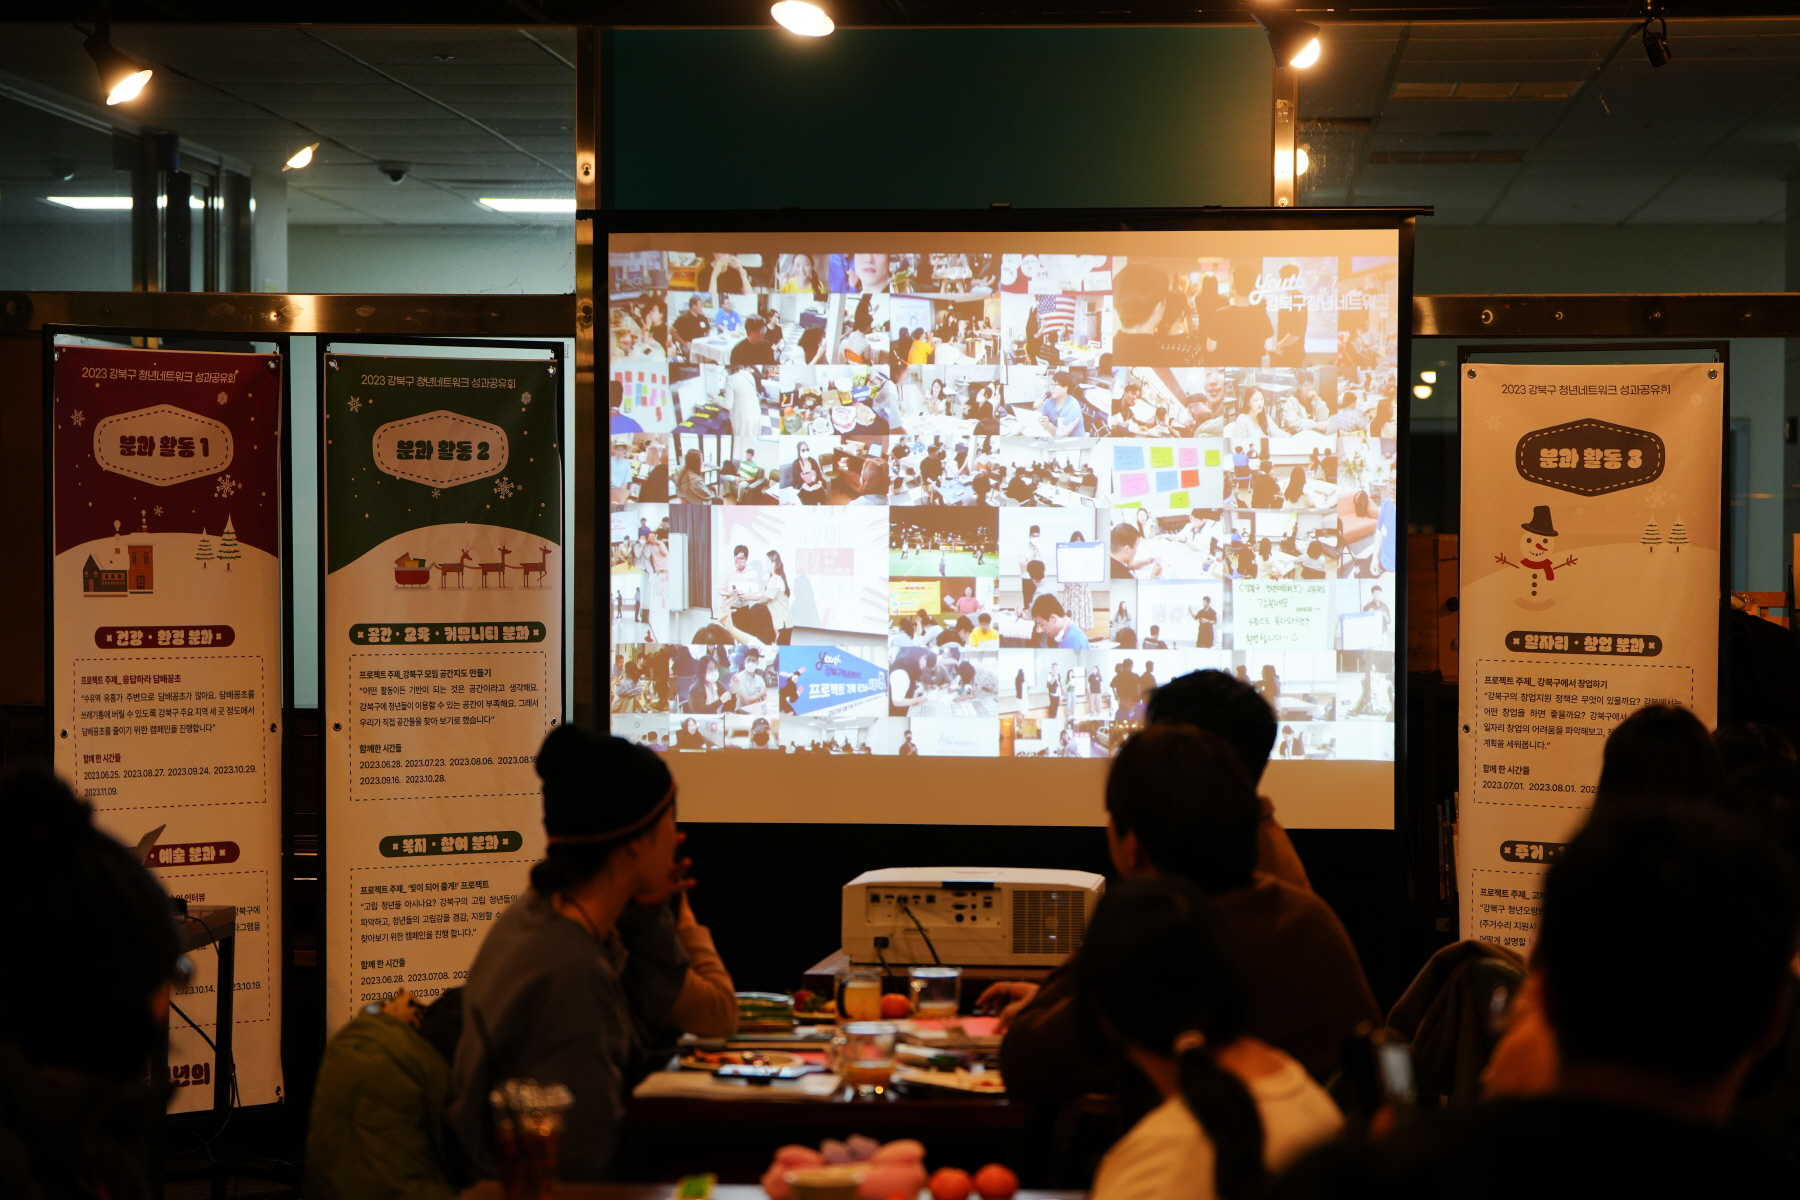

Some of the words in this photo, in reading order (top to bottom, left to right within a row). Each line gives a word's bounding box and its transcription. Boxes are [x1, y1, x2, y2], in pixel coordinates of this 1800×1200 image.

[81, 367, 107, 379] 2023
[109, 369, 136, 380] 강북구
[139, 370, 193, 382] 청년네트워크
[195, 372, 236, 384] 성과공유회
[361, 374, 385, 385] 2023
[388, 376, 414, 387] 강북구
[416, 376, 469, 388] 청년네트워크
[472, 378, 516, 389] 성과공유회
[1502, 384, 1526, 394] 2023
[1528, 384, 1557, 395] 강북구
[1559, 385, 1617, 396] 청년네트워크
[119, 435, 156, 457] 분과
[160, 436, 195, 458] 활동
[200, 438, 210, 457] 1
[396, 440, 433, 460] 분과
[438, 440, 473, 461] 활동
[477, 441, 490, 461] 2
[1540, 448, 1579, 469] 분과
[1583, 448, 1622, 470] 활동
[1627, 449, 1642, 469] 3
[116, 630, 143, 646] 건강
[158, 630, 185, 646] 환경
[188, 629, 213, 645] 분과
[368, 626, 393, 642] 공간
[404, 626, 430, 642] 교육
[444, 625, 499, 641] 커뮤니티
[502, 625, 529, 641] 분과
[1524, 634, 1569, 651] 일자리
[1583, 636, 1612, 652] 창업
[1616, 637, 1645, 653] 분과
[81, 675, 103, 685] 프로젝트
[122, 674, 151, 684] 응답하라
[153, 674, 181, 684] 담배꽁초
[359, 670, 387, 679] 프로젝트
[424, 670, 438, 679] 모임
[440, 669, 468, 679] 공간지도
[470, 668, 492, 678] 만들기
[359, 686, 377, 695] “어떤
[381, 686, 406, 695] 활동이든
[409, 685, 428, 694] 기반이
[433, 685, 447, 694] 되는
[451, 684, 465, 694] 것은
[469, 684, 505, 693] 공간이라고
[510, 683, 538, 692] 생각해요.
[1484, 676, 1514, 685] 프로젝트
[1538, 678, 1576, 688] 강북구에서
[1578, 679, 1607, 689] 창업하기
[104, 693, 123, 703] 유흥가
[126, 692, 155, 702] 주변으로
[158, 692, 192, 702] 담배꽁초가
[195, 690, 216, 700] 많아요.
[219, 690, 255, 700] 담배꽁초를
[1484, 692, 1517, 701] “강북구의
[1521, 693, 1551, 702] 창업지원
[1555, 694, 1578, 703] 정책은
[1581, 695, 1604, 705] 무엇이
[1607, 696, 1640, 706] 있을까요?
[359, 702, 387, 712] 강북구에
[388, 702, 413, 711] 청년들이
[415, 701, 436, 710] 이용할
[437, 701, 444, 709] 수
[446, 700, 460, 709] 있는
[462, 700, 484, 709] 공간이
[486, 699, 516, 708] 부족해요.
[518, 699, 539, 708] 그래서
[81, 710, 111, 720] 쓰레기통에
[112, 710, 125, 719] 버릴
[127, 710, 133, 718] 수
[135, 709, 157, 718] 있도록
[158, 708, 179, 718] 강북구
[180, 708, 193, 717] 주요
[195, 707, 208, 716] 지역
[226, 706, 254, 716] 정도에서
[1484, 707, 1498, 717] 어떤
[1502, 708, 1525, 717] 창업을
[1530, 709, 1546, 718] 하면
[1550, 709, 1586, 719] 좋을까요?
[1590, 711, 1627, 721] 강북구에서
[359, 718, 381, 727] 우리가
[382, 718, 395, 727] 직접
[397, 717, 422, 726] 공간들을
[423, 716, 438, 726] 찾아
[440, 716, 461, 725] 보기로
[81, 727, 111, 737] 담배꽁초를
[112, 726, 132, 735] 줄이기
[134, 725, 148, 735] 위한
[150, 724, 178, 734] 캠페인을
[179, 723, 216, 733] 진행합니다”
[1484, 723, 1505, 733] 일자리
[1507, 724, 1529, 733] 창업의
[1532, 725, 1563, 735] 어려움을
[1565, 726, 1605, 737] 파악해보고,
[383, 743, 402, 753] 시간들
[1483, 739, 1504, 748] 계획을
[83, 754, 94, 764] 함께
[103, 753, 121, 763] 시간들
[360, 760, 402, 769] 2023.06.28.
[405, 759, 446, 768] 2023.07.23.
[450, 757, 494, 766] 2023.08.06.
[84, 771, 120, 780] 2023.06.25.
[124, 769, 164, 778] 2023.08.27.
[168, 767, 210, 776] 2023.09.24.
[214, 765, 257, 774] 2023.10.29.
[1483, 764, 1497, 774] 함께
[1507, 766, 1530, 776] 시간들
[360, 776, 401, 785] 2023.09.16.
[406, 774, 446, 784] 2023.10.28.
[85, 787, 118, 796] 2023.11.09.
[1482, 780, 1524, 790] 2023.07.01.
[1529, 783, 1576, 793] 2023.08.01.
[402, 838, 426, 854] 복지
[440, 835, 468, 852] 참여
[472, 835, 499, 851] 분과
[158, 847, 185, 864] 예술
[189, 845, 216, 862] 분과
[1515, 844, 1544, 860] 주거
[360, 885, 388, 894] 프로젝트
[425, 883, 439, 892] 되어
[461, 880, 489, 889] 프로젝트
[1480, 888, 1509, 898] 프로젝트
[185, 893, 205, 902] 인터뷰
[360, 902, 378, 910] “고립
[381, 901, 401, 910] 청년을
[404, 899, 436, 908] 아시나요?
[440, 897, 468, 907] 강북구의
[472, 896, 485, 905] 고립
[1480, 904, 1505, 913] “강북구
[360, 917, 390, 927] 파악하고,
[392, 915, 420, 925] 청년들의
[422, 914, 450, 923] 고립감을
[453, 912, 468, 922] 경감,
[471, 911, 492, 921] 지원할
[1480, 920, 1511, 930] (주거수리
[361, 933, 389, 943] 찾아보기
[390, 932, 404, 941] 위한
[405, 931, 433, 940] 캠페인을
[435, 930, 448, 939] 진행
[1503, 937, 1526, 946] 설명할
[361, 960, 376, 969] 함께
[385, 958, 406, 968] 시간들
[361, 975, 404, 985] 2023.06.28.
[408, 972, 450, 982] 2023.07.08.
[175, 985, 215, 995] 2023.10.14.
